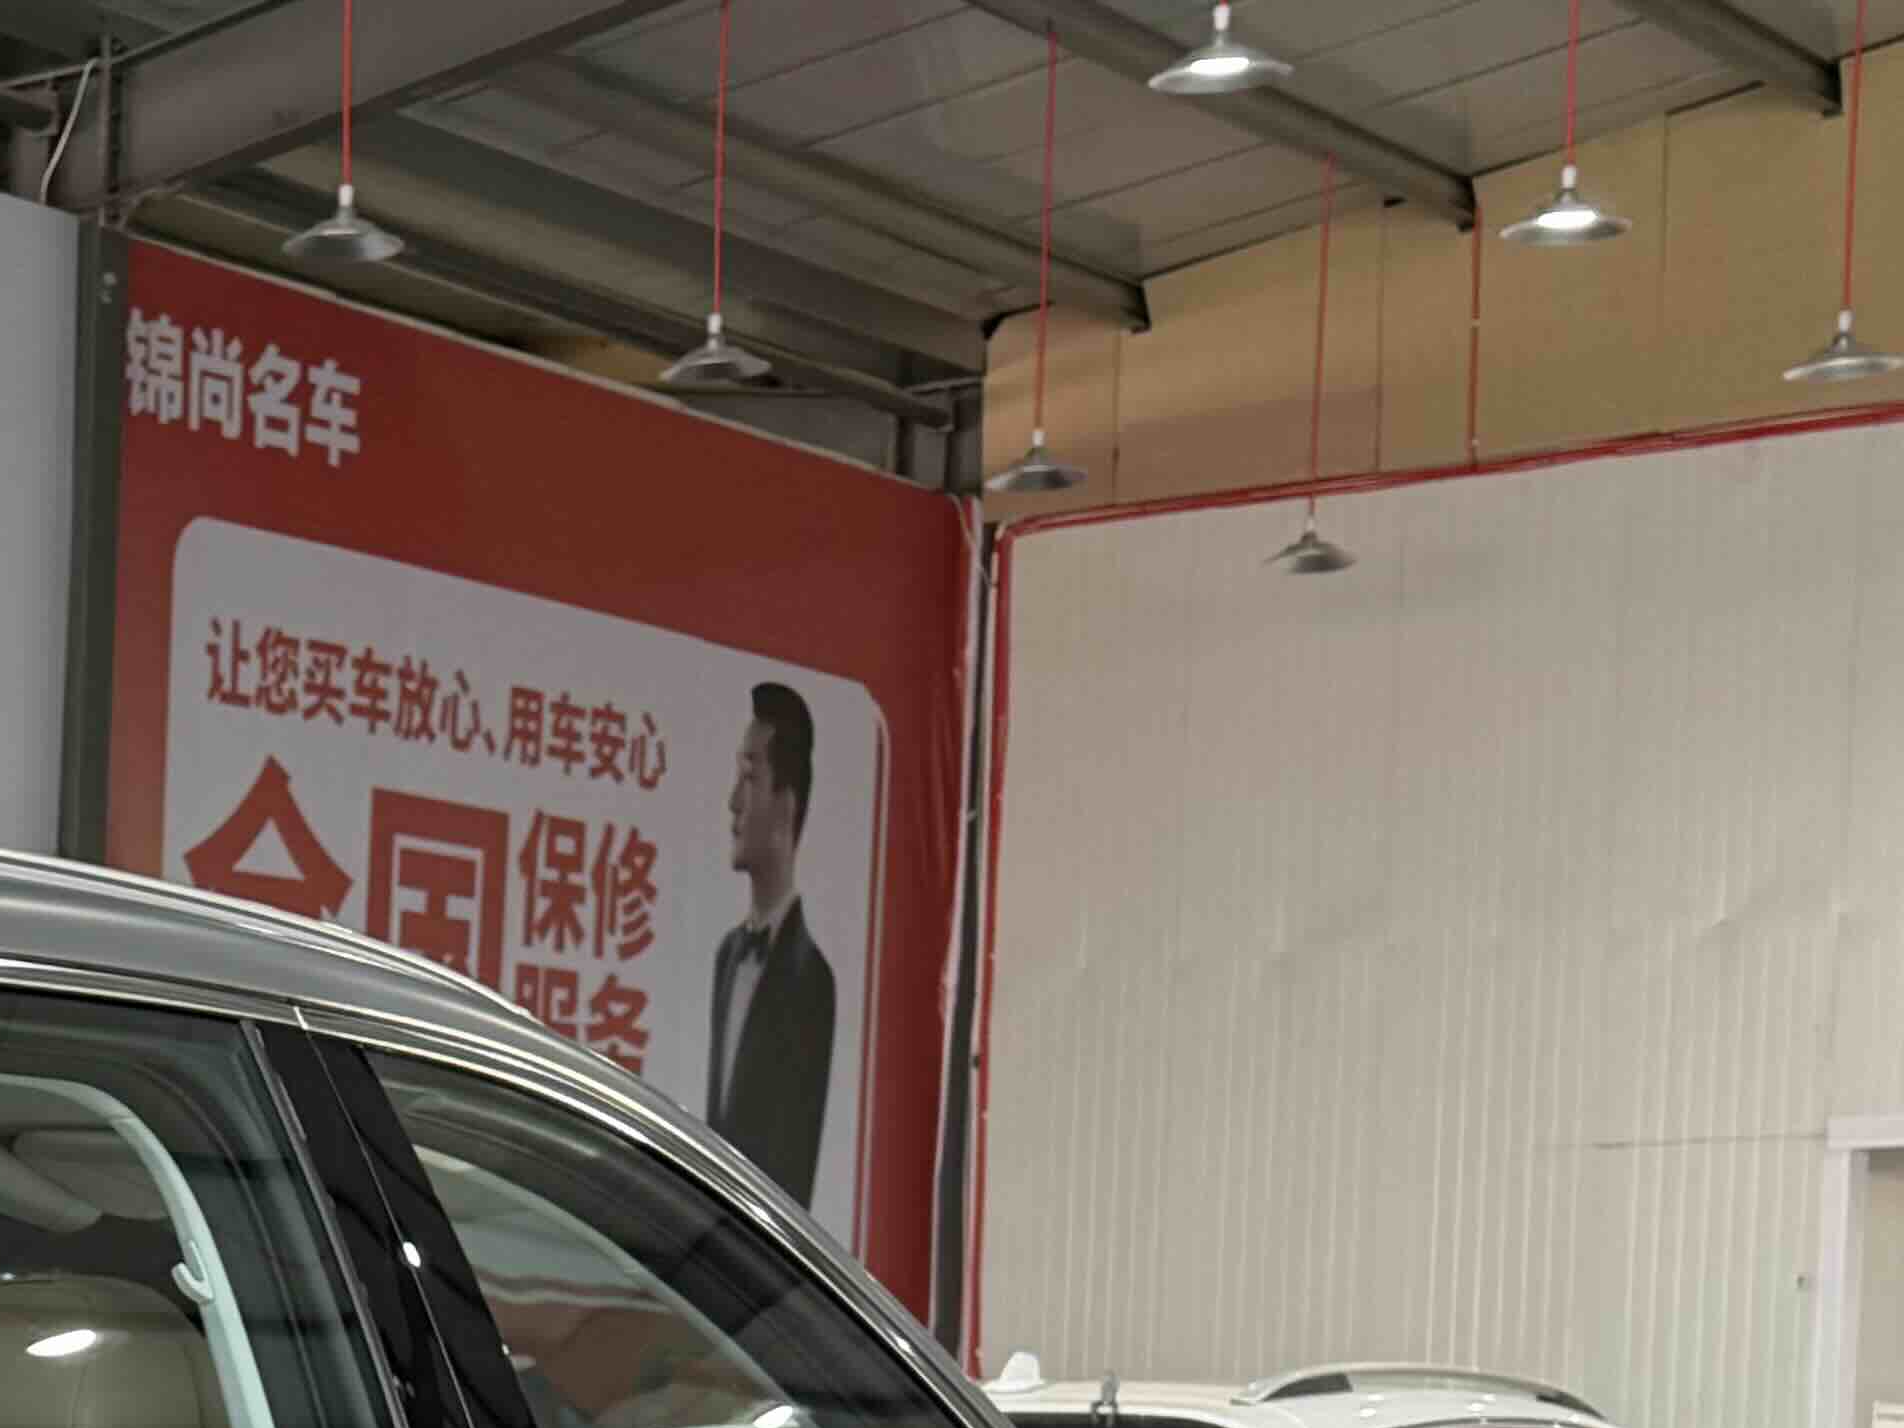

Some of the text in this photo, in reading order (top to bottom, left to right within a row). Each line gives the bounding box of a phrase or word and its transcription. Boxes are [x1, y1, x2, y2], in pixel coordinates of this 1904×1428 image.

[125, 306, 361, 467] 锦尚名车
[518, 811, 658, 961] 保修
